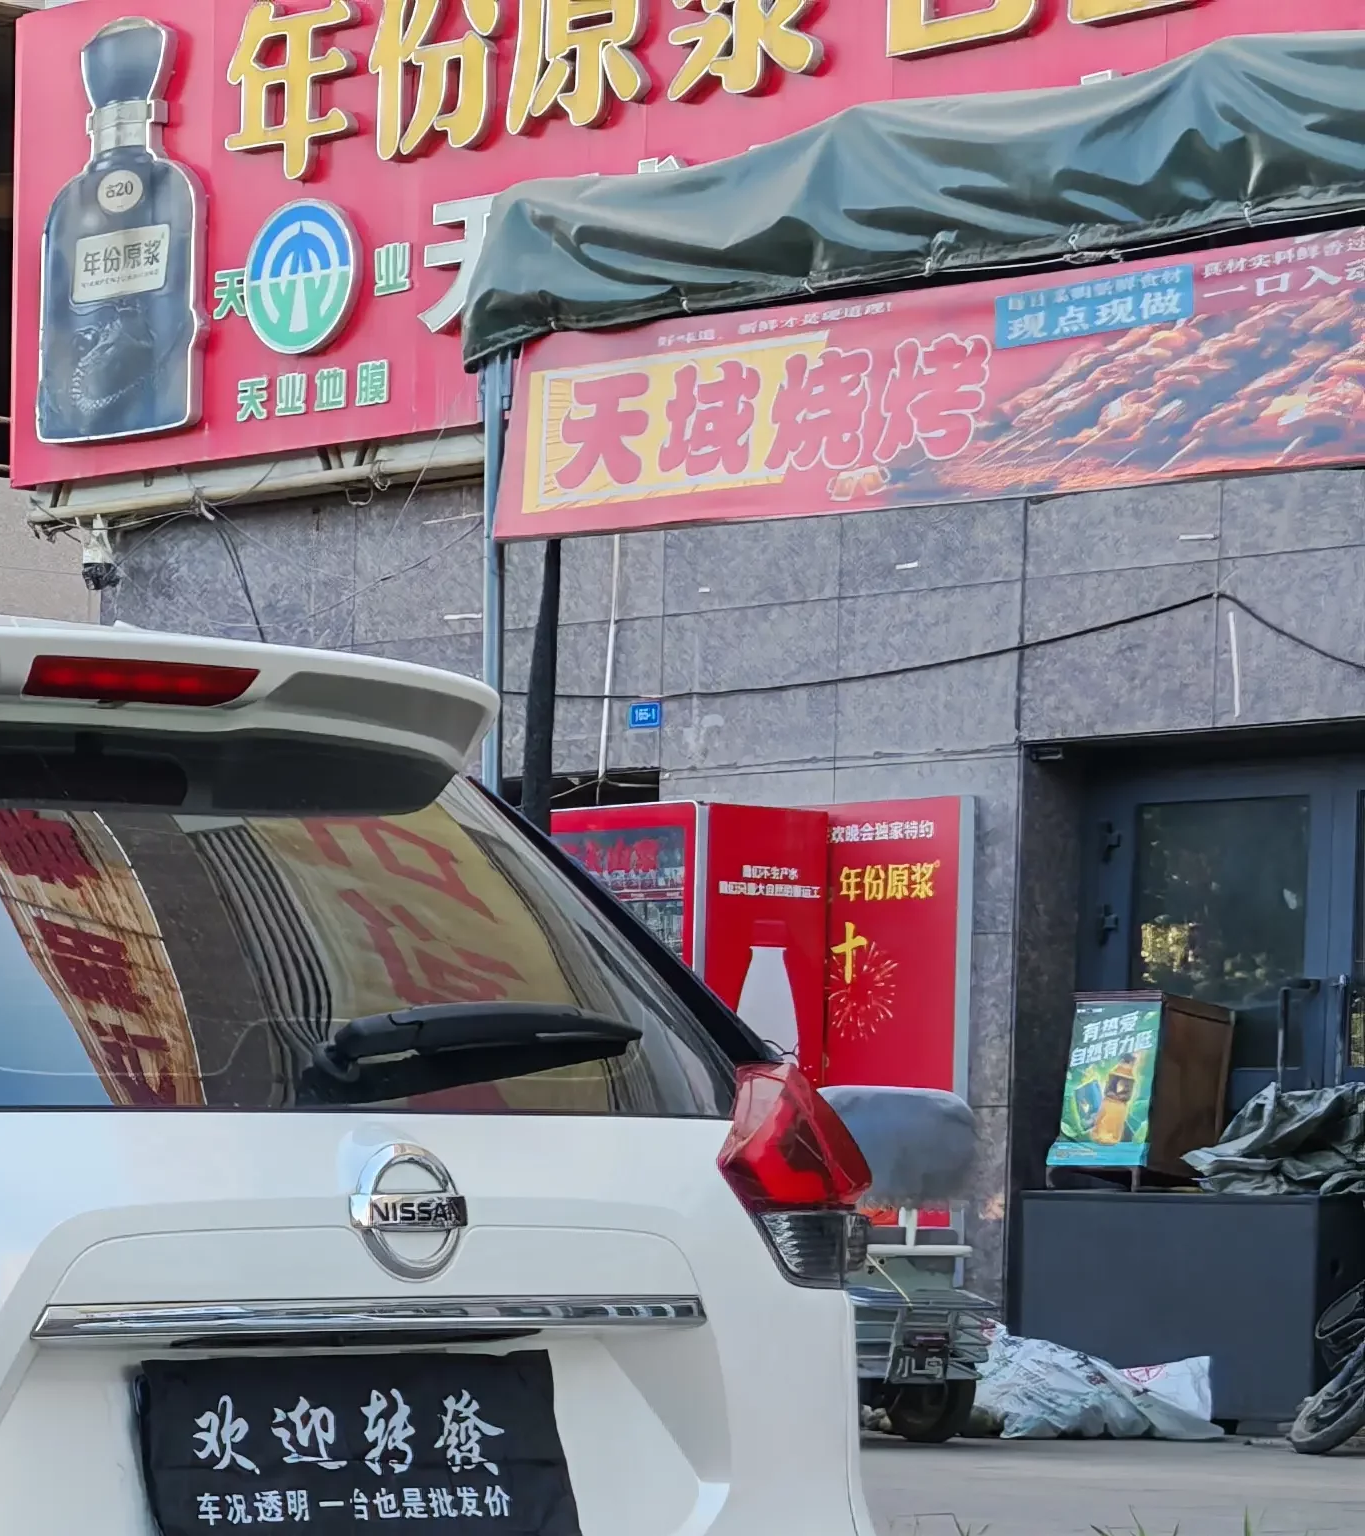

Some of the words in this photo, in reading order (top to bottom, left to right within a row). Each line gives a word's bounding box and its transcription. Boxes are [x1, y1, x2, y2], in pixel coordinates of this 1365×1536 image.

[83, 240, 162, 275] 年份原浆
[1007, 288, 1182, 341] 现点现做
[236, 359, 389, 422] 天业地膜
[554, 332, 992, 490] 天域烧烤
[827, 820, 935, 843] 欢晚会独家特约
[370, 1199, 462, 1223] NISSAN
